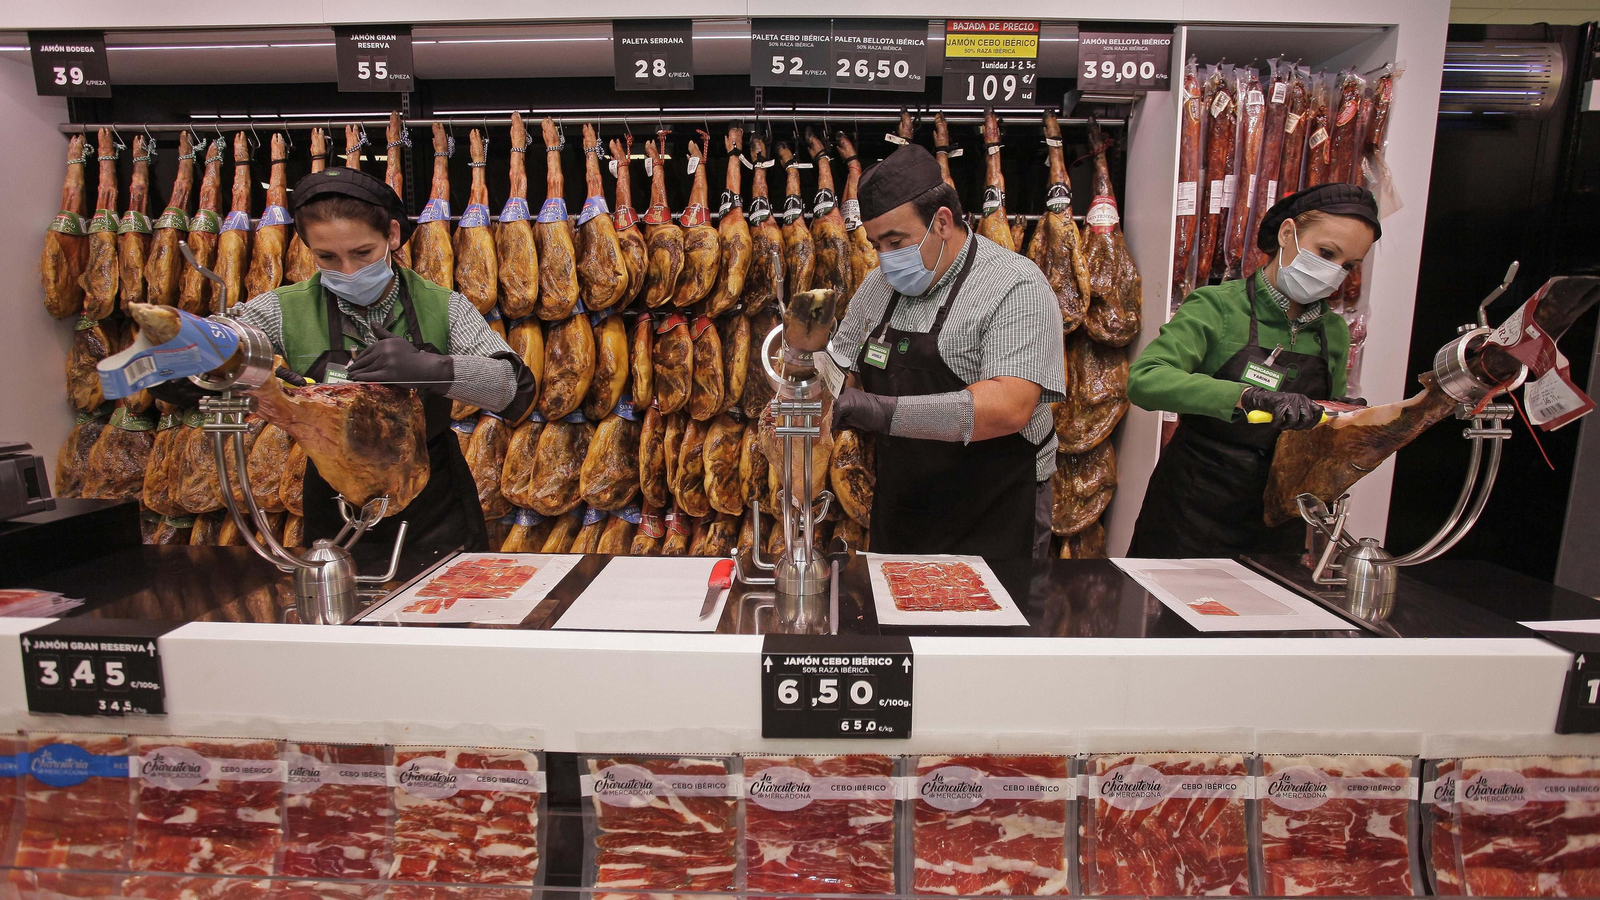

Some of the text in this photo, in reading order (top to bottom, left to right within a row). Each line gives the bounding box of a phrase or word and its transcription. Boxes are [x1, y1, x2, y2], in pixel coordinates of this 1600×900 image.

[952, 22, 1035, 31] BAJADA DE PRECIO
[350, 32, 376, 41] JAMÓN
[780, 34, 800, 42] CEBO
[801, 34, 830, 42] IBÉRICA
[834, 36, 925, 46] PALETA BELLOTA IBÉRICA
[946, 37, 976, 46] JAMÓN
[1002, 38, 1036, 47] IBÉRICO
[1142, 38, 1171, 46] IBÉRICO
[40, 44, 65, 52] JAMÓN
[358, 61, 388, 80] 55
[635, 58, 666, 78] 28
[771, 56, 804, 76] 52
[836, 58, 910, 82] 26,50
[1083, 60, 1156, 82] 39,00
[53, 66, 84, 86] 39
[966, 74, 1017, 102] 109
[1022, 92, 1032, 100] ud
[1250, 364, 1280, 378] MERCADONA
[32, 640, 146, 652] JAMÓN GRAN RESERVA
[784, 656, 893, 666] JAMÓN CEBO IBÉRICO
[38, 660, 126, 688] 3,45
[802, 666, 818, 674] 50%
[840, 666, 870, 674] IBÉRICA
[778, 678, 912, 708] 6,50 €/100g.
[242, 766, 273, 774] IBÉRICO
[339, 770, 360, 778] CEBO
[498, 776, 529, 785] IBÉRICO
[695, 782, 726, 790] IBÉRICO
[830, 784, 886, 792] CEBO IBÉRICO
[1002, 784, 1060, 792] CEBO IBÉRICO
[1204, 782, 1236, 790] IBÉRICO
[1347, 784, 1402, 792] CEBO IBÉRICO
[1568, 785, 1600, 793] IBÉRICO
